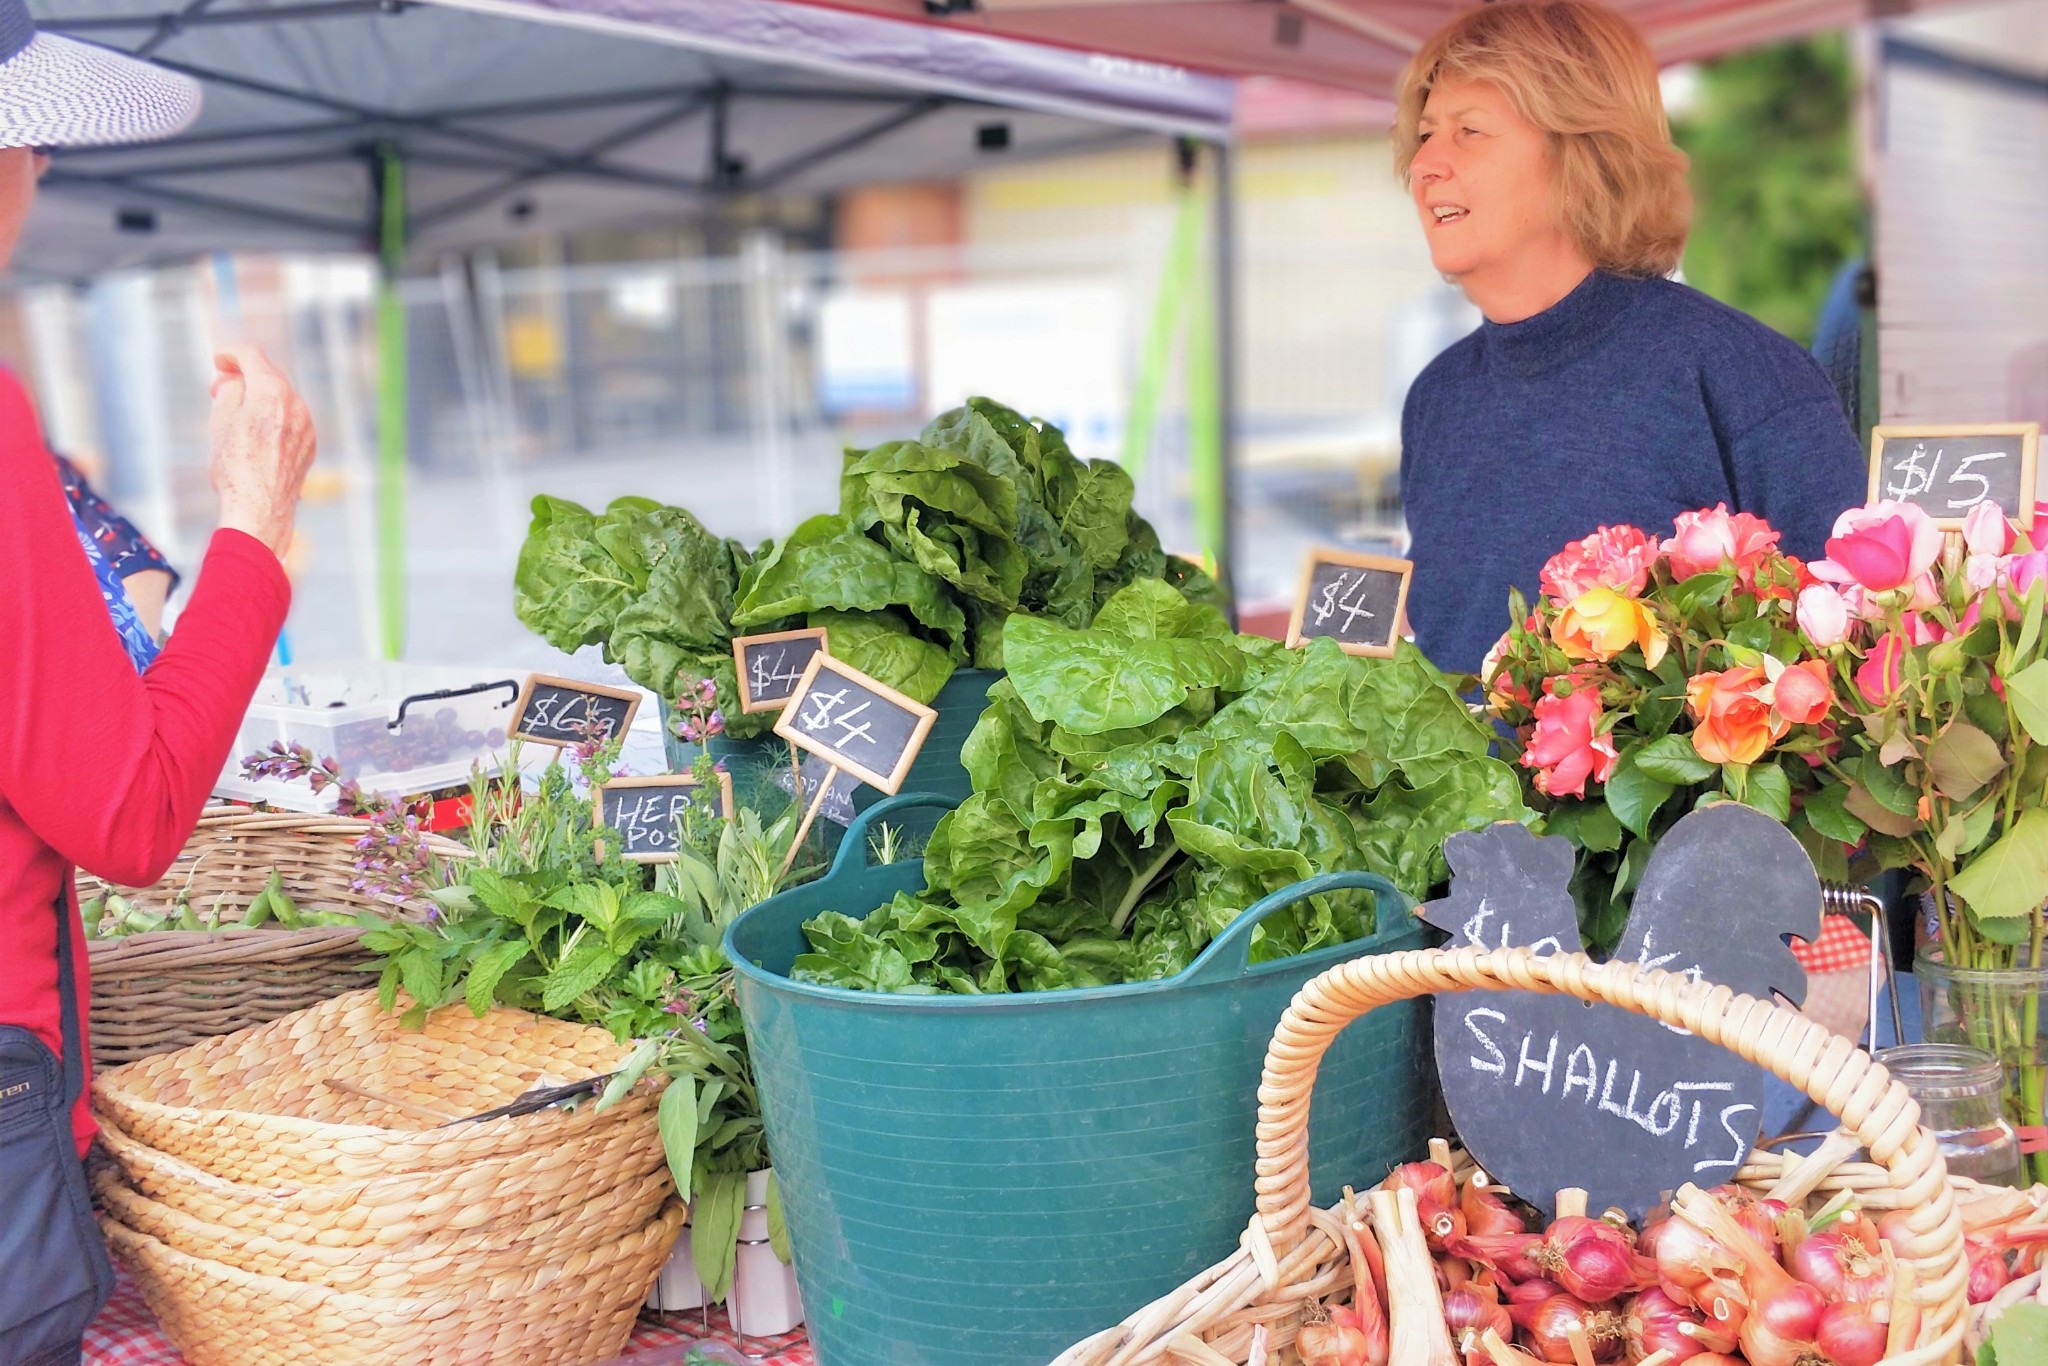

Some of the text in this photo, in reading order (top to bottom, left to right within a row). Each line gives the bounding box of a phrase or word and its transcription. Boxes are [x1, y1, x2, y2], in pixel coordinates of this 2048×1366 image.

[1887, 443, 2007, 508] $15
[1312, 572, 1375, 633] $4
[750, 649, 804, 697] $4
[801, 688, 877, 748] $4
[614, 794, 715, 830] HER
[1464, 1007, 1757, 1172] SHALLOTS
